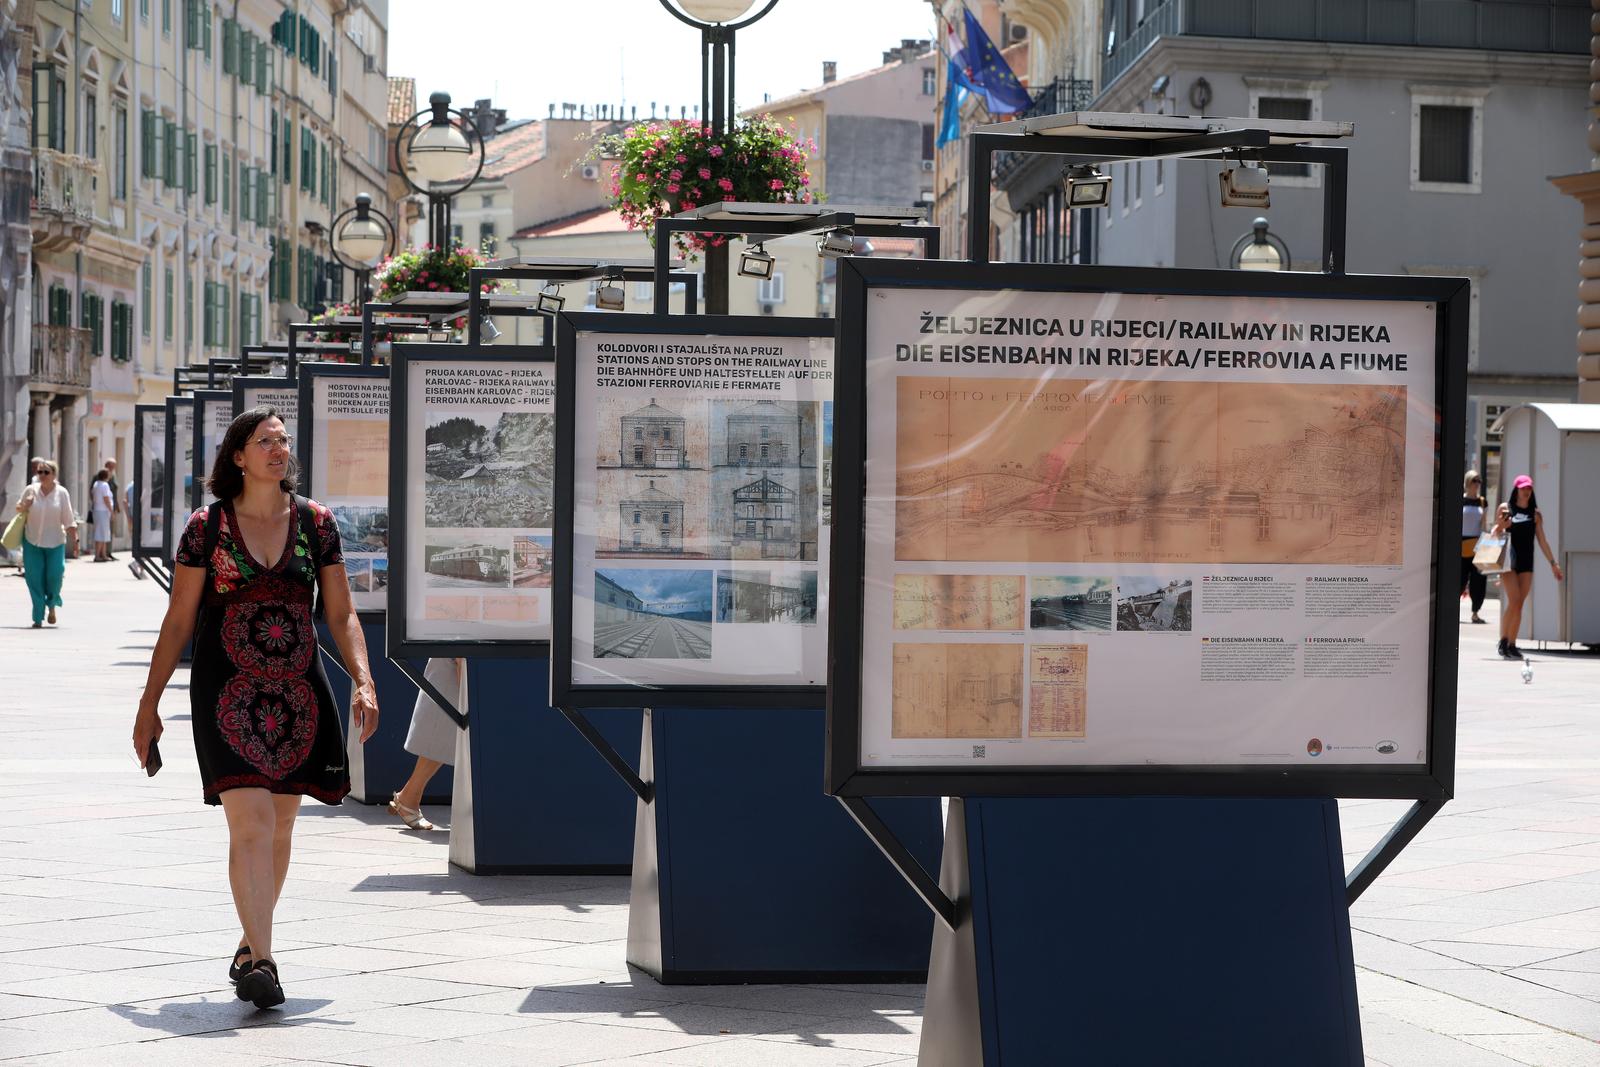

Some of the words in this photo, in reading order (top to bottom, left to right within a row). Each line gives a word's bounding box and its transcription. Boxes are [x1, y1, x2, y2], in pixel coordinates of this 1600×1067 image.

[919, 311, 1064, 337] ŽELJEZNICA
[1069, 319, 1084, 337] U
[1282, 323, 1304, 341] IN
[1309, 324, 1391, 344] RIJEKA
[597, 343, 658, 353] KOLODVORI
[666, 344, 732, 355] STAJALIŠTA
[733, 346, 749, 355] NA
[750, 346, 783, 356] PRUZI
[596, 355, 650, 365] STATIONS
[651, 356, 675, 365] AND
[676, 356, 712, 366] STOPS
[714, 357, 729, 366] ON
[731, 358, 753, 367] THE
[755, 358, 802, 368] RAILWAY
[803, 359, 828, 368] LINE
[895, 344, 934, 363] DIE
[939, 345, 1072, 365] EISENBAHN
[1079, 348, 1101, 366] IN
[1319, 352, 1336, 370] A
[1340, 352, 1408, 372] FIUME
[425, 368, 456, 377] PRUGA
[456, 369, 503, 378] KARLOVAC
[511, 370, 543, 378] RIJEKA
[597, 366, 615, 376] DIE
[617, 366, 677, 377] BAHNHÖFE
[679, 368, 702, 377] UND
[704, 369, 785, 379] HALTESTELLEN
[787, 370, 809, 379] AUF
[811, 371, 832, 380] DER
[425, 378, 472, 386] KARLOVAC
[479, 378, 511, 387] RIJEKA
[512, 379, 550, 387] RAILWAY
[596, 378, 647, 388] STAZIONI
[648, 379, 720, 389] FERROVIARIE
[722, 381, 729, 389] E
[731, 381, 781, 390] FERMATE
[425, 387, 476, 395] EISENBAHN
[477, 388, 523, 396] KARLOVAC
[425, 396, 469, 405] FERROVIA
[470, 397, 516, 405] KARLOVAC
[523, 397, 550, 405] FIUME
